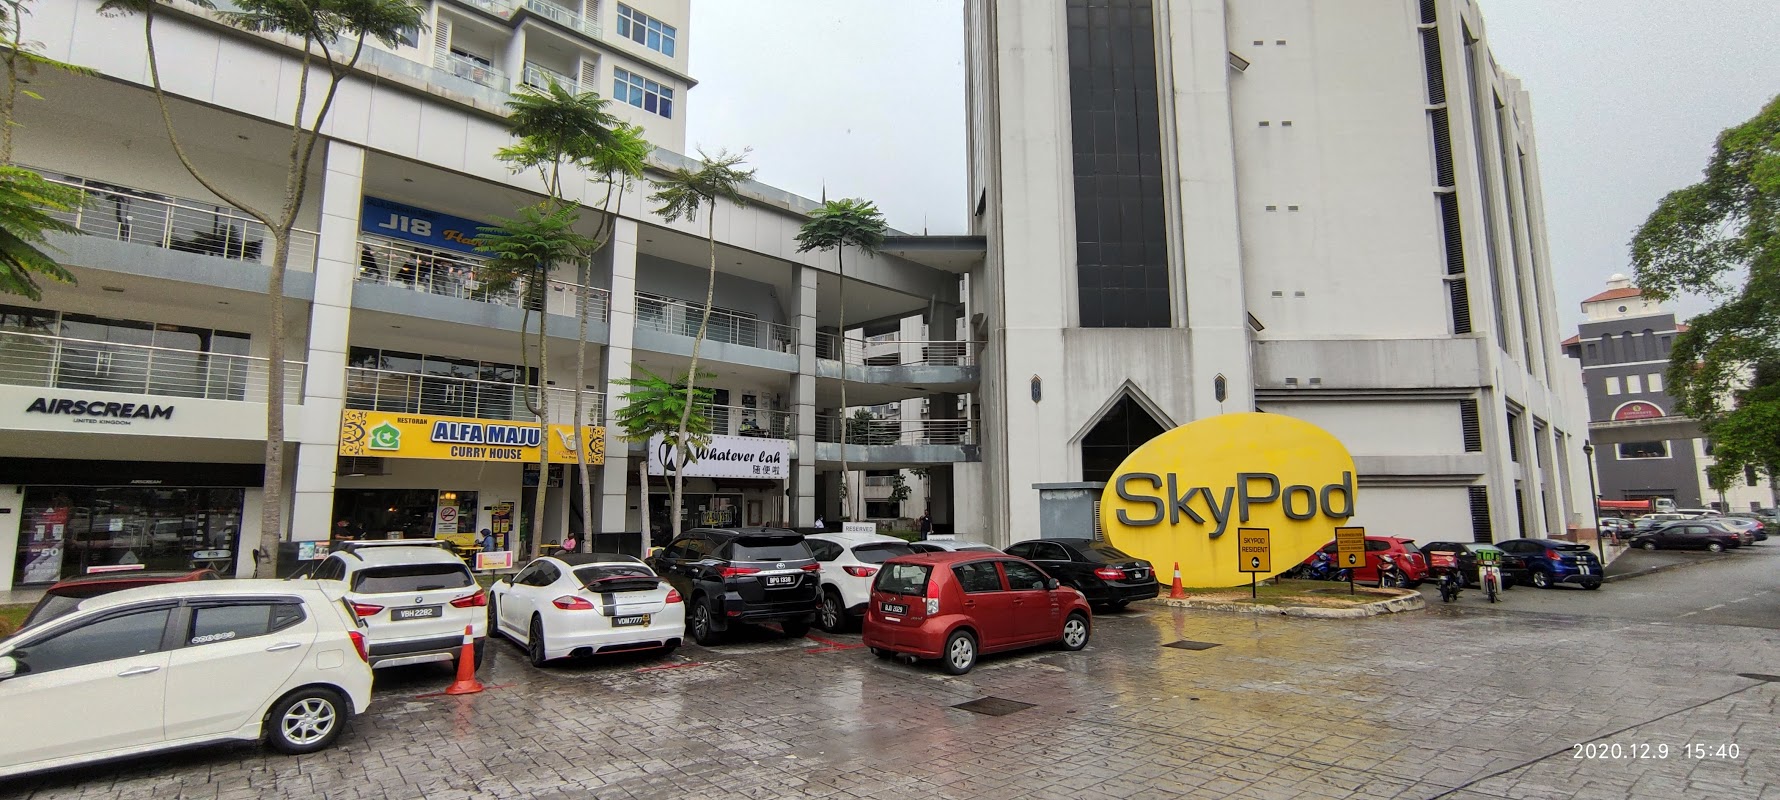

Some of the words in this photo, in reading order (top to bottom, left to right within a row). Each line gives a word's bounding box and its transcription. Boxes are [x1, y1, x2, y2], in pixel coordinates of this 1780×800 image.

[378, 213, 432, 237] J18
[26, 397, 174, 420] AIRSCREAM
[397, 417, 428, 425] RESTORAN
[432, 421, 484, 443] ALFA
[486, 424, 541, 447] MAJU
[450, 446, 487, 458] CURRY
[489, 447, 522, 460] HOUSE
[695, 447, 755, 463] Whatever
[758, 450, 781, 464] lah
[752, 465, 780, 476] 随便啦
[1115, 470, 1355, 539] SkyPod
[845, 525, 873, 533] RESERVED
[400, 610, 415, 618] VBH
